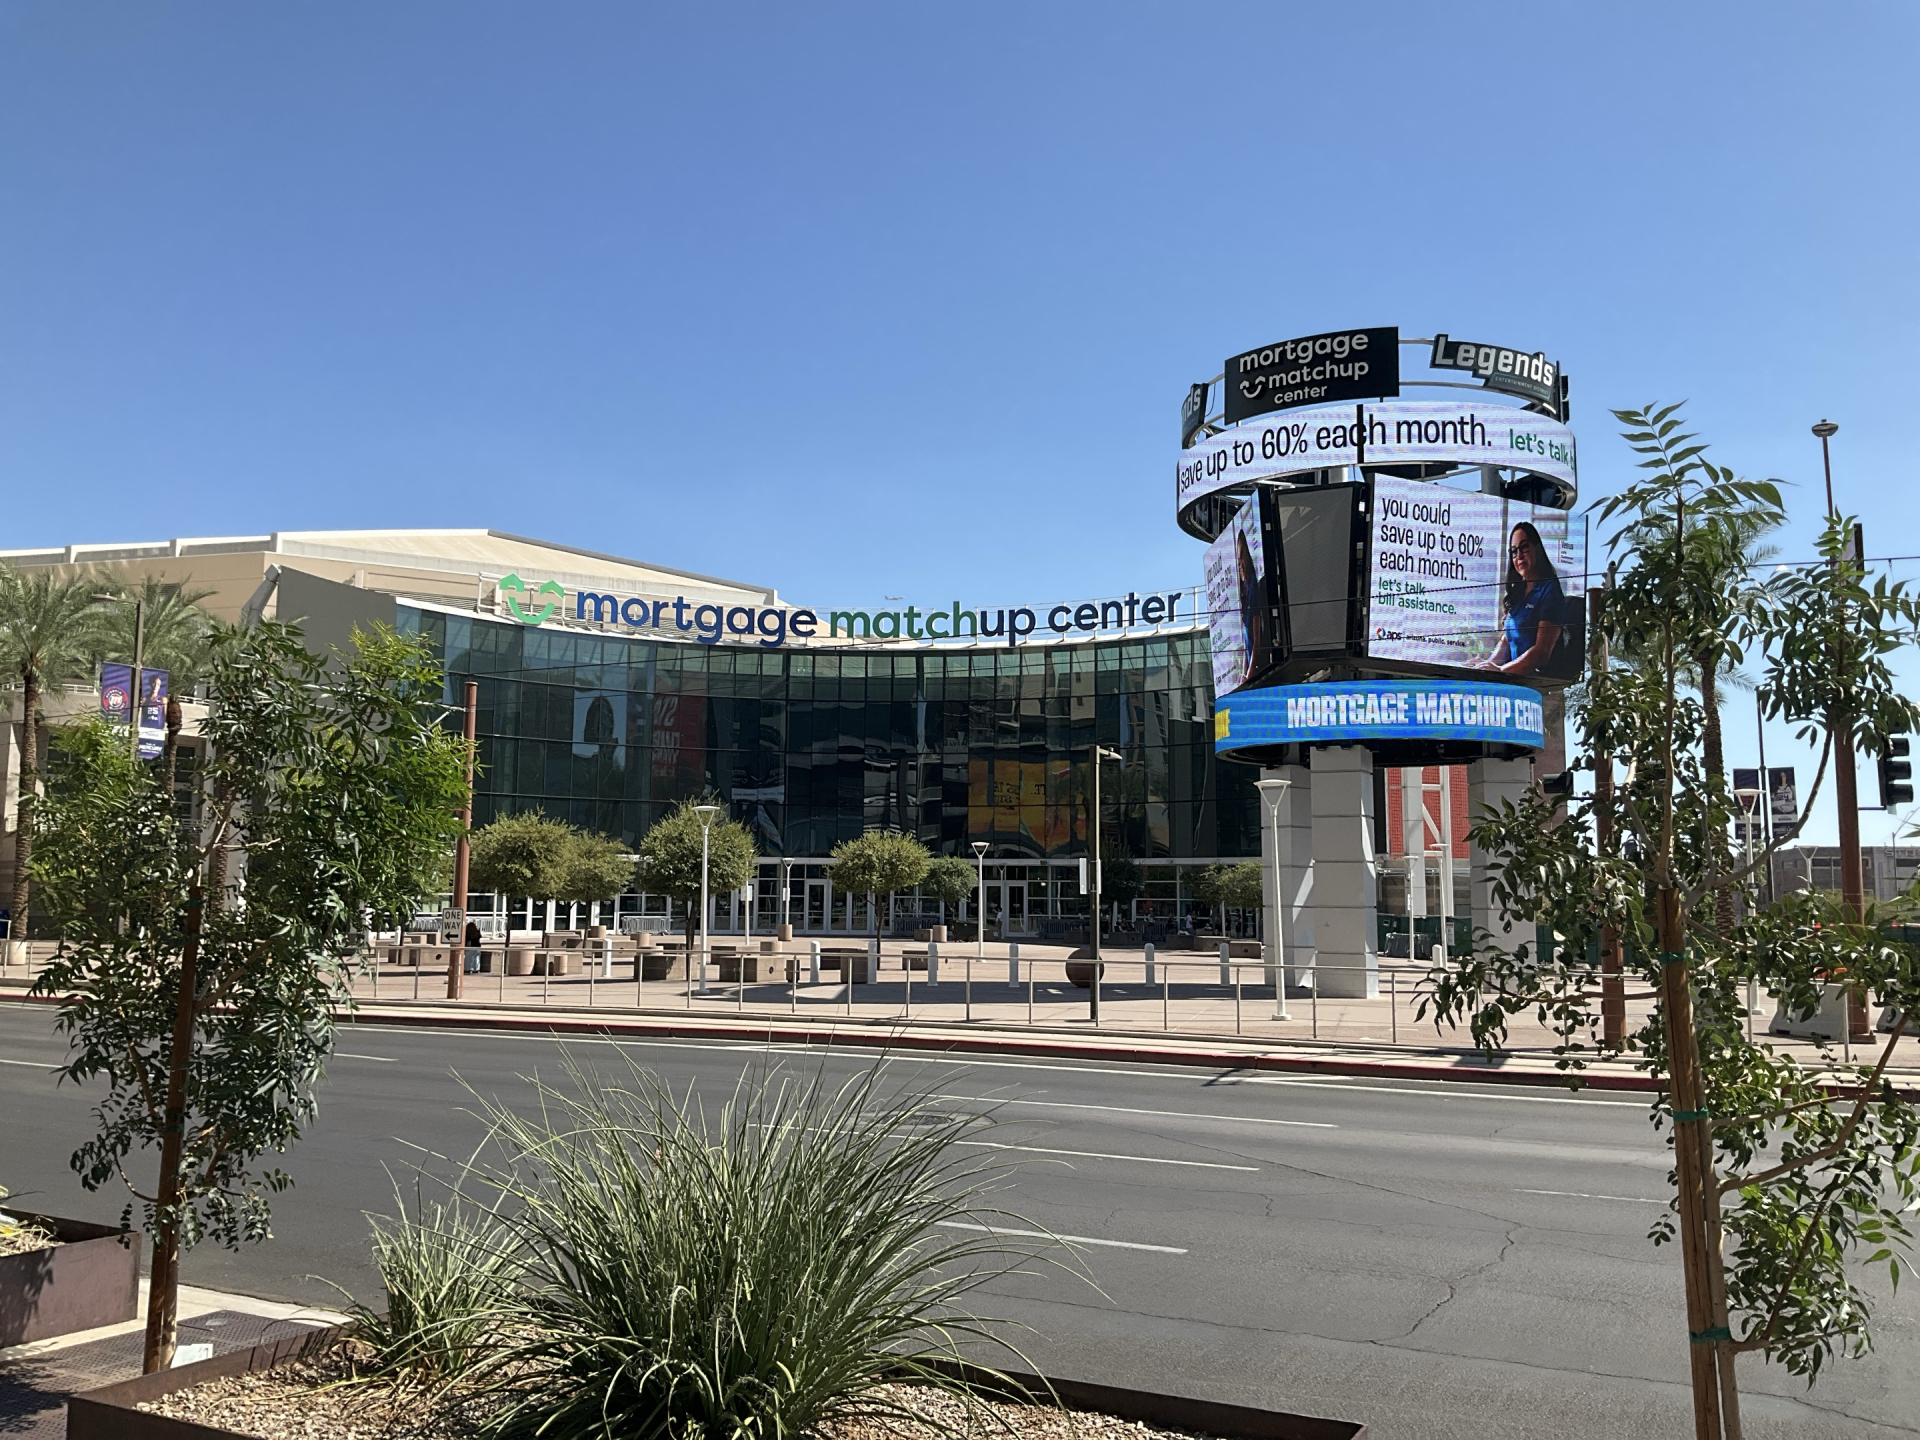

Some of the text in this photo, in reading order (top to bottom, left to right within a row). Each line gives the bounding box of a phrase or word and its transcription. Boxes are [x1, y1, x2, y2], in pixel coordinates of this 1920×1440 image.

[1239, 333, 1369, 373] mortgage
[1435, 336, 1553, 387] Legends
[1268, 360, 1369, 389] matchup
[1274, 384, 1328, 405] center
[1180, 459, 1203, 493] save
[1206, 449, 1228, 481] up
[1232, 440, 1255, 467] to
[1261, 422, 1308, 460] 60%
[1315, 413, 1387, 450] each
[1396, 413, 1492, 447] month.
[1549, 439, 1569, 466] talk
[1381, 497, 1451, 527] you could
[1380, 524, 1484, 558] save up to 60%
[1379, 549, 1467, 581] each month.
[1378, 591, 1457, 615] bill assistance.
[1404, 581, 1426, 595] talk
[576, 591, 819, 648] mortgage
[830, 601, 1037, 648] matchup
[1047, 591, 1183, 634] center
[1386, 629, 1402, 642] aps
[1287, 692, 1409, 729] MORTGAGE
[1416, 692, 1512, 728] MATCHUP
[444, 921, 461, 930] WAY
[445, 911, 461, 920] ONE
